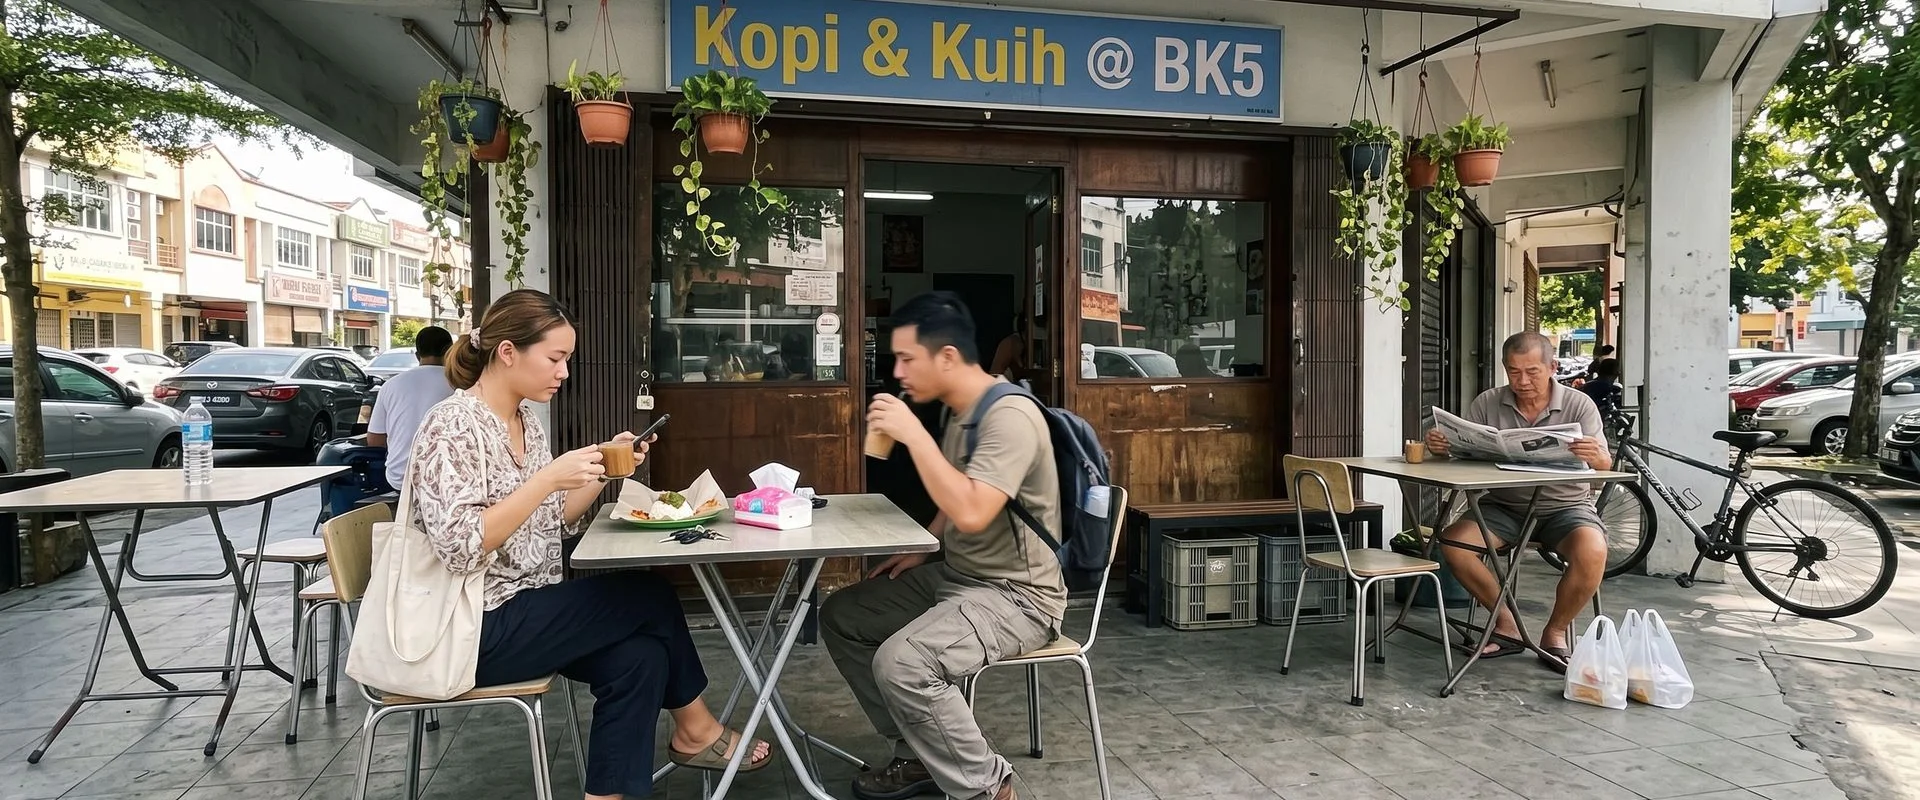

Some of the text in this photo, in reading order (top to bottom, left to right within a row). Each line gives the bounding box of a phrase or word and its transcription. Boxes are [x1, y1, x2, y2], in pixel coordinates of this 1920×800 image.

[695, 5, 1265, 98] Kopi & Kuih @ BK5
